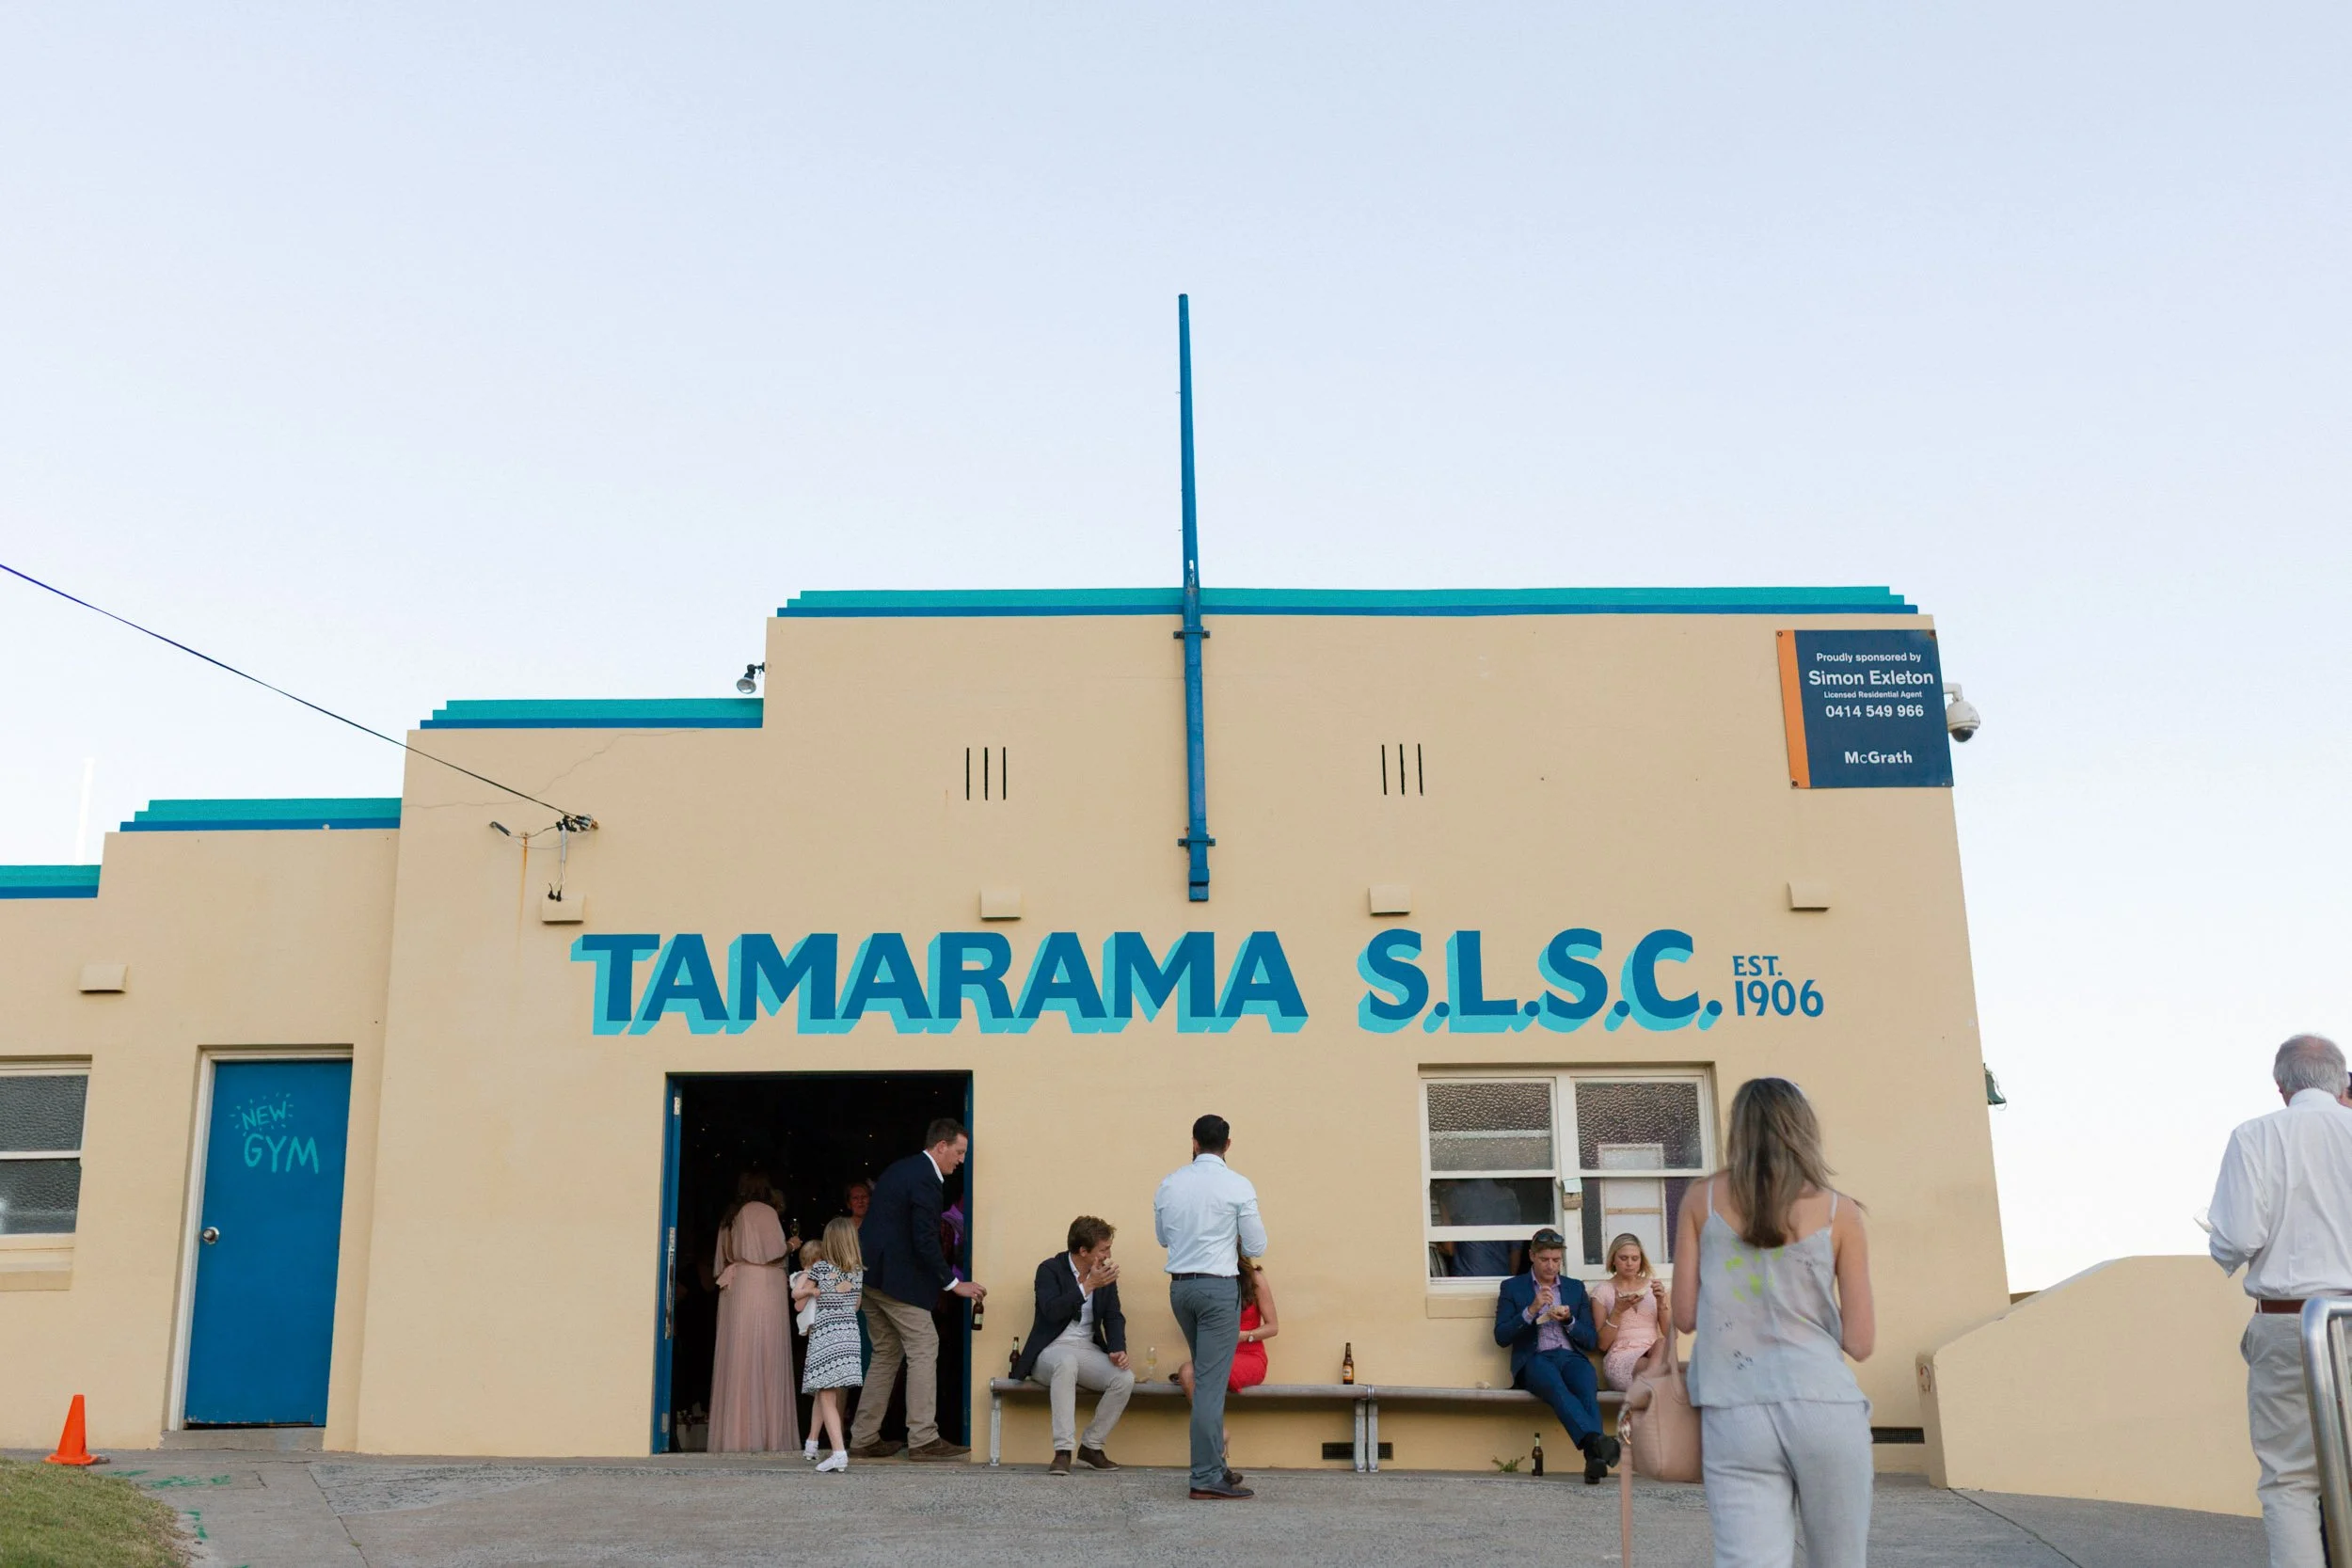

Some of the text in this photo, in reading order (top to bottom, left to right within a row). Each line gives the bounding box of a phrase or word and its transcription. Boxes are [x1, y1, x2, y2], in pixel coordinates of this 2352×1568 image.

[1817, 653, 1921, 662] Proudly sponsored by
[1808, 670, 1934, 686] Simon Exleton
[1858, 690, 1899, 699] Residential
[1900, 690, 1922, 700] Agent
[1825, 705, 1924, 718] 0414 549 966
[1844, 751, 1913, 764] McGrath
[1732, 955, 1783, 976] EST.
[572, 928, 1723, 1034] TAMARAMA S.L.S.C.
[1734, 979, 1824, 1017] 1906
[242, 1101, 287, 1131] NEW
[245, 1132, 319, 1174] GYM
